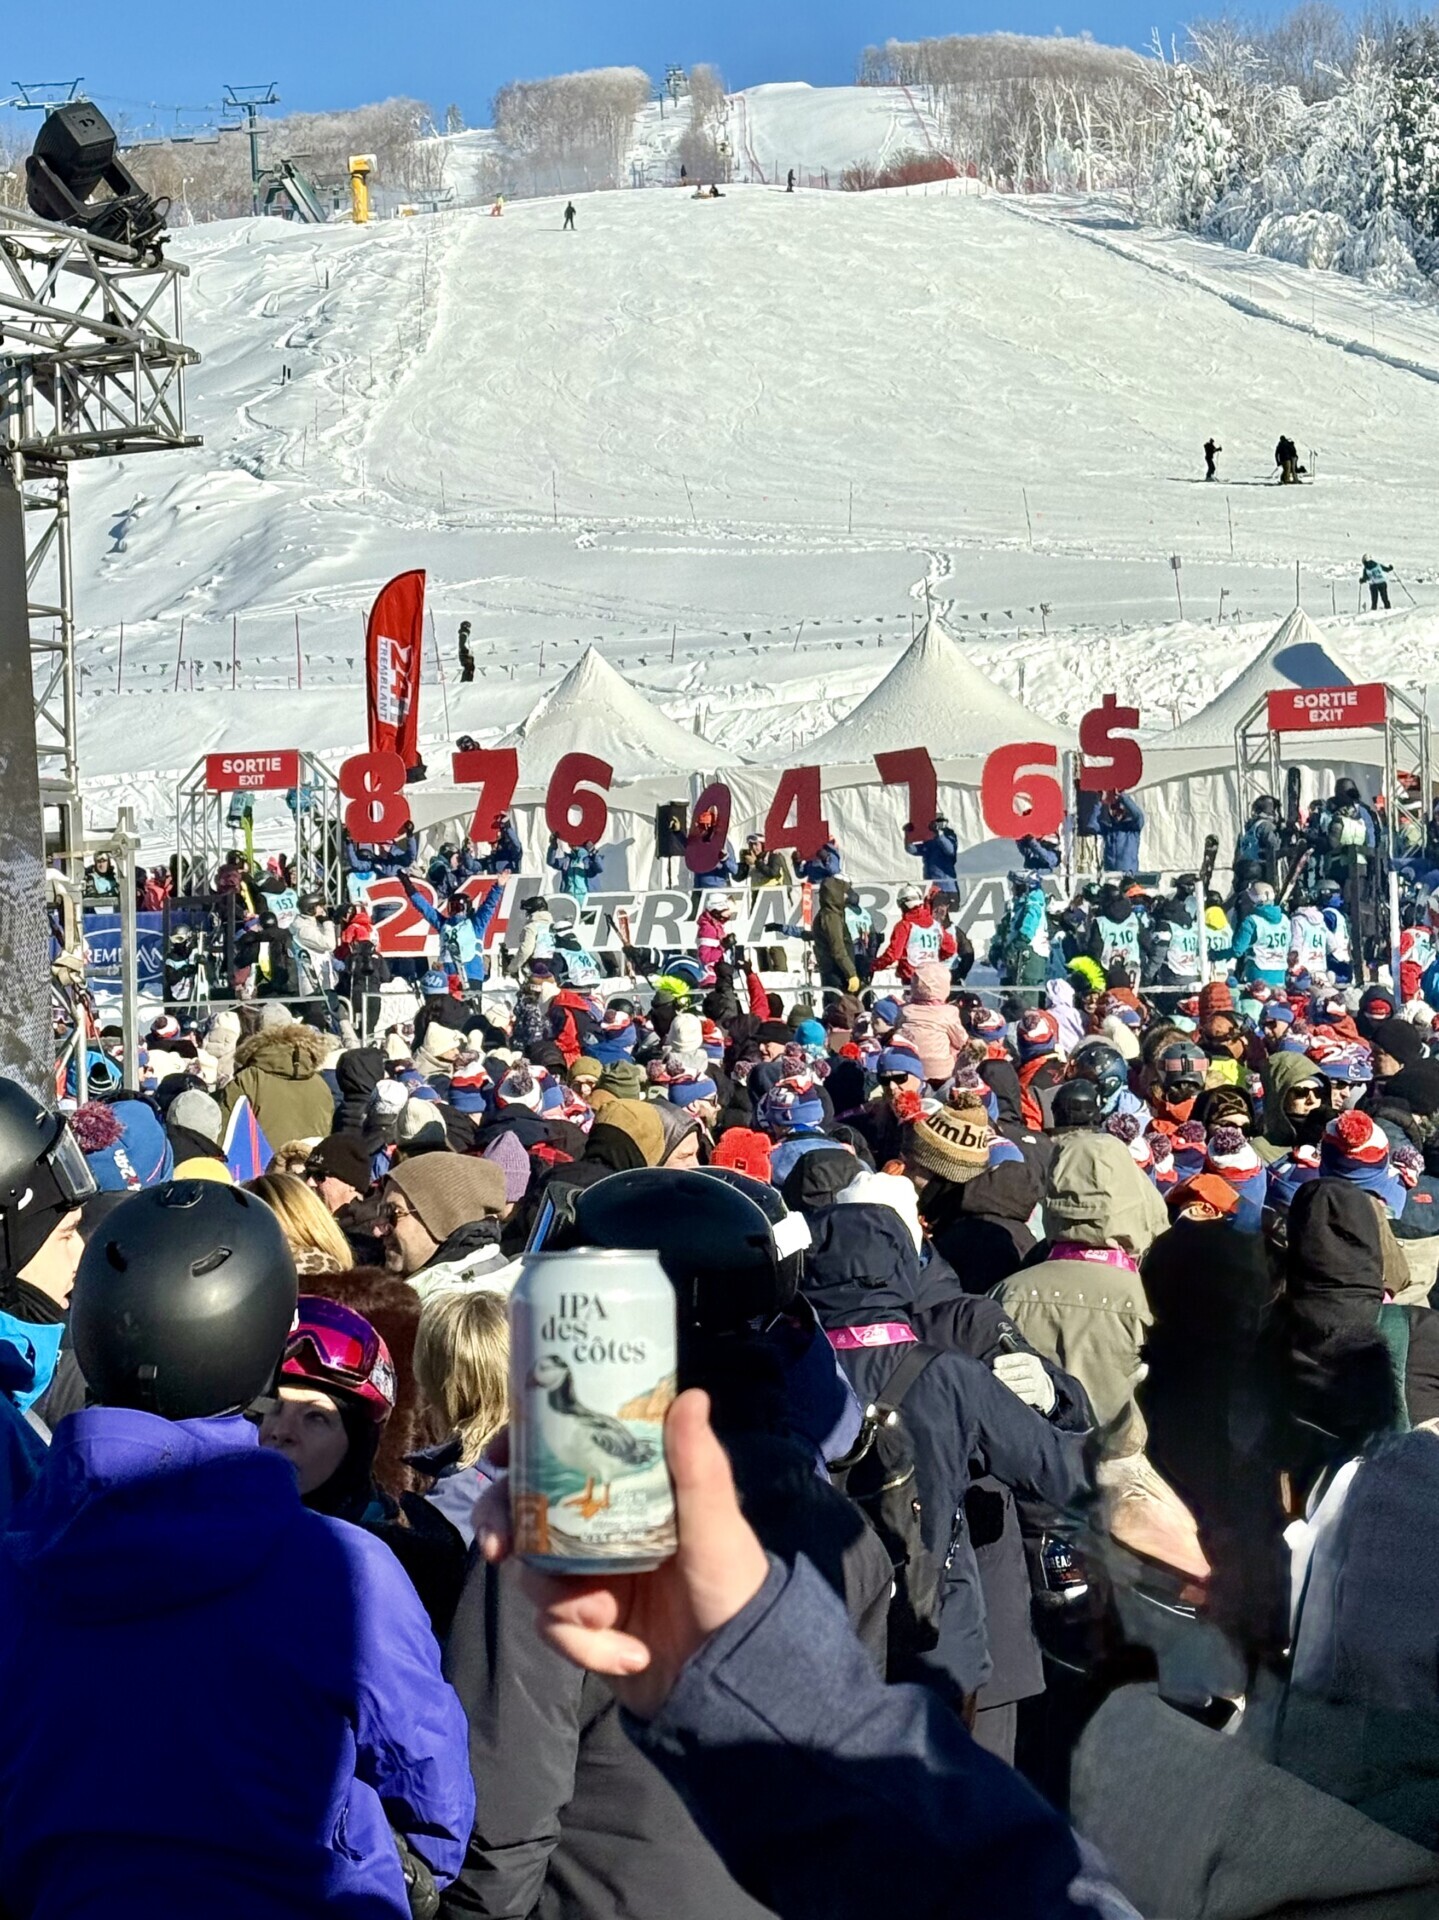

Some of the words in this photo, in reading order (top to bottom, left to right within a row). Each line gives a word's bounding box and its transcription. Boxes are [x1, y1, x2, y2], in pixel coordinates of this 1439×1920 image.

[379, 639, 389, 720] TREMBLANT
[1293, 691, 1358, 709] SORTIE
[1309, 708, 1344, 723] EXIT
[222, 757, 282, 774] SORTIE
[239, 774, 265, 786] EXIT
[339, 752, 410, 843] 8
[452, 748, 518, 843] 7
[545, 752, 613, 847] 6
[764, 766, 829, 861] 4
[874, 747, 938, 844] 7
[981, 742, 1064, 840] 6
[275, 897, 294, 911] 153
[1109, 929, 1134, 947] 210
[1266, 932, 1287, 948] 250
[559, 1292, 607, 1320] IPA
[541, 1314, 588, 1342] des
[573, 1335, 647, 1364] côtes
